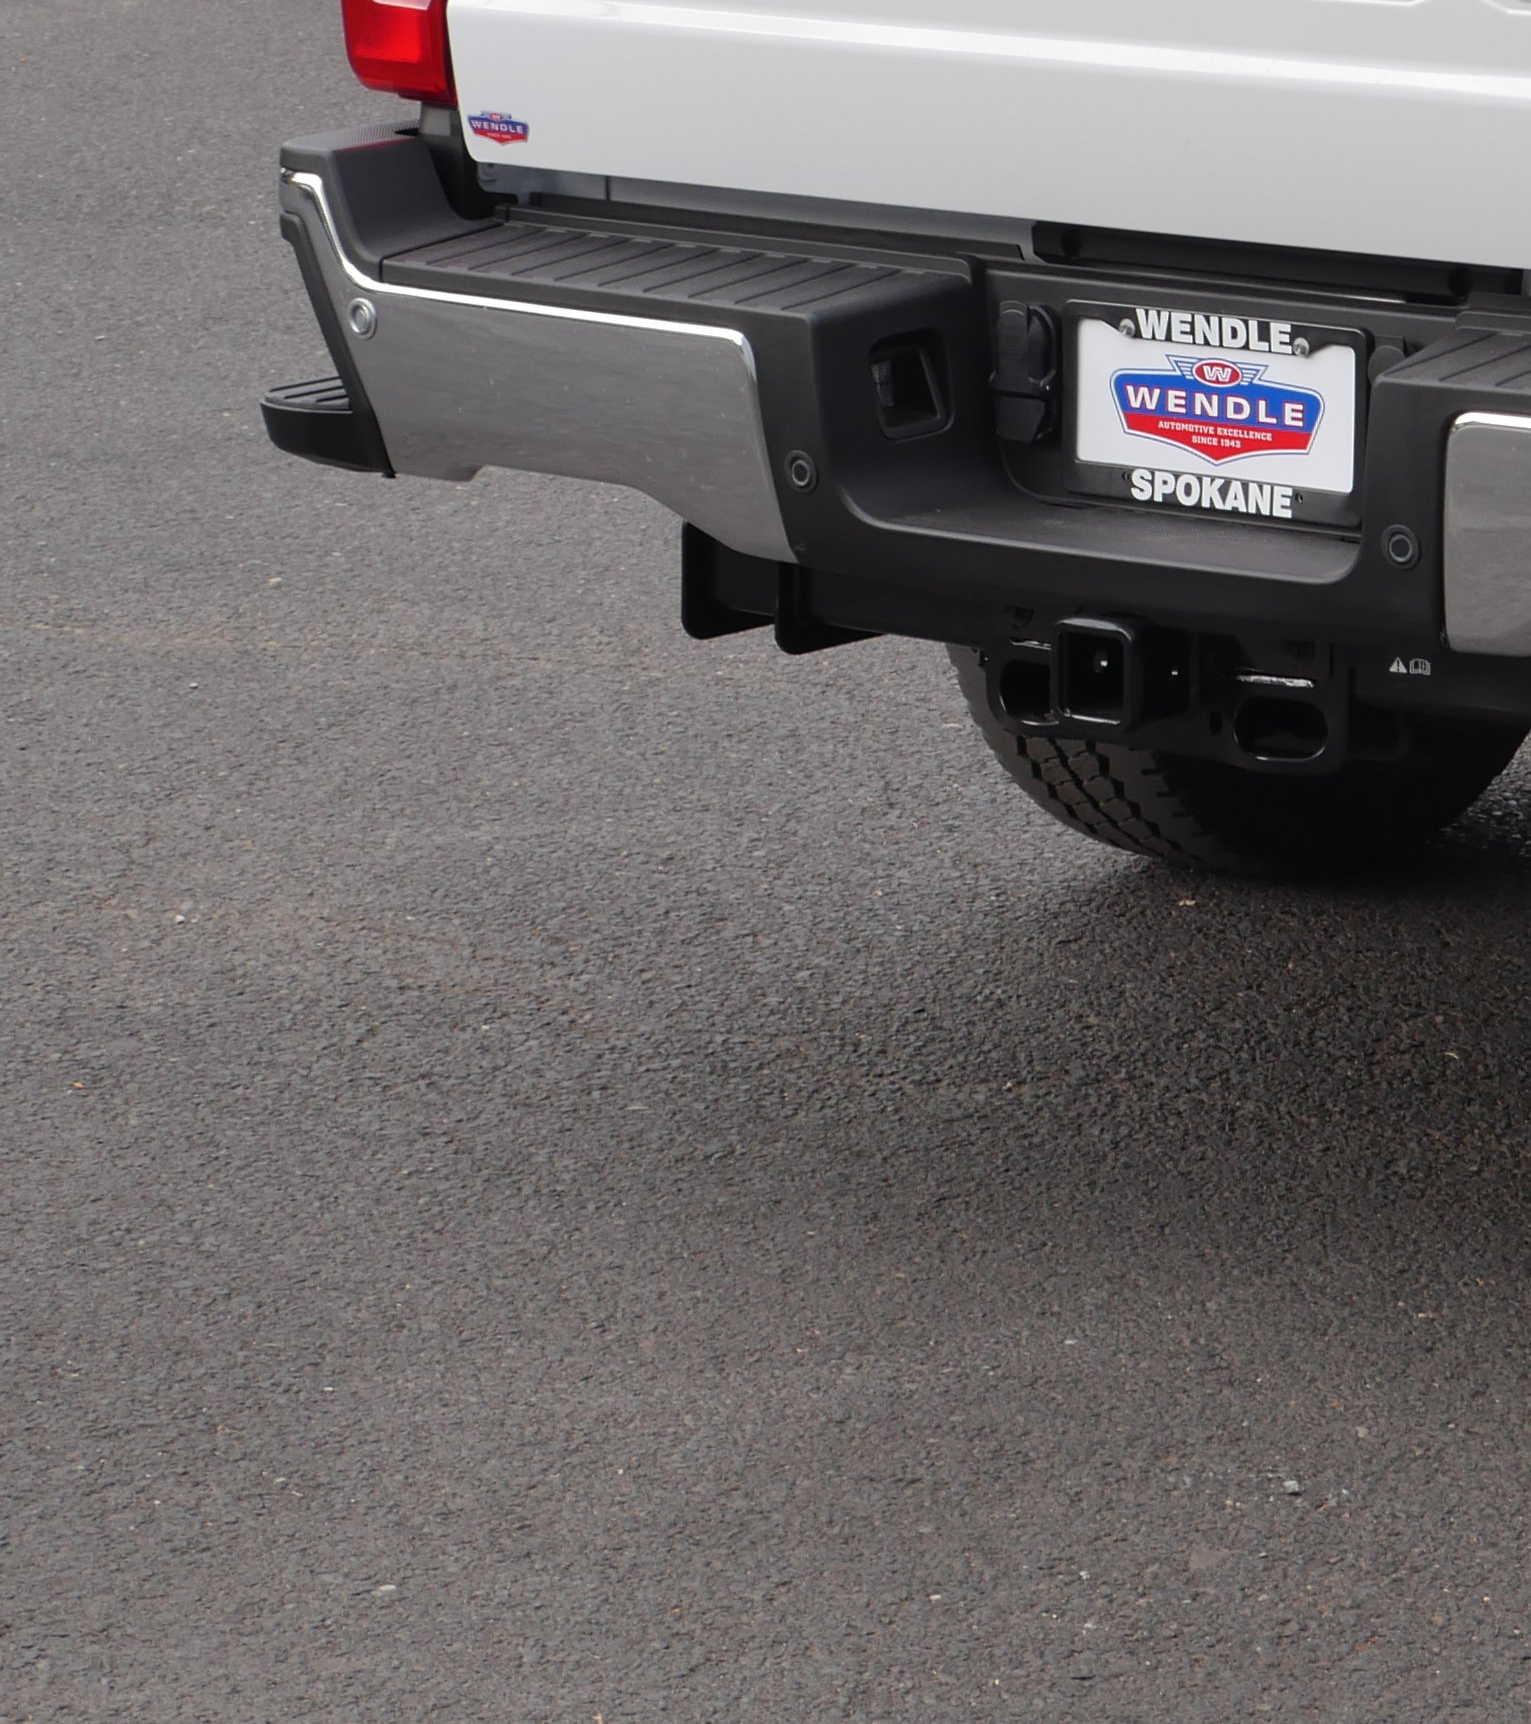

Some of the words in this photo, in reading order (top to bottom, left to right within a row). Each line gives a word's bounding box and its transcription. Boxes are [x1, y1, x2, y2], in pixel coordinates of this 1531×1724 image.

[472, 120, 523, 133] WENDLE
[1135, 308, 1293, 354] WENDLE
[1125, 384, 1304, 428] WENDLE
[1158, 420, 1215, 435] AUTOMOTIVE
[1216, 427, 1273, 442] EXCELLENCE
[1191, 435, 1218, 447] SINCE
[1130, 468, 1293, 519] SPOKANE
